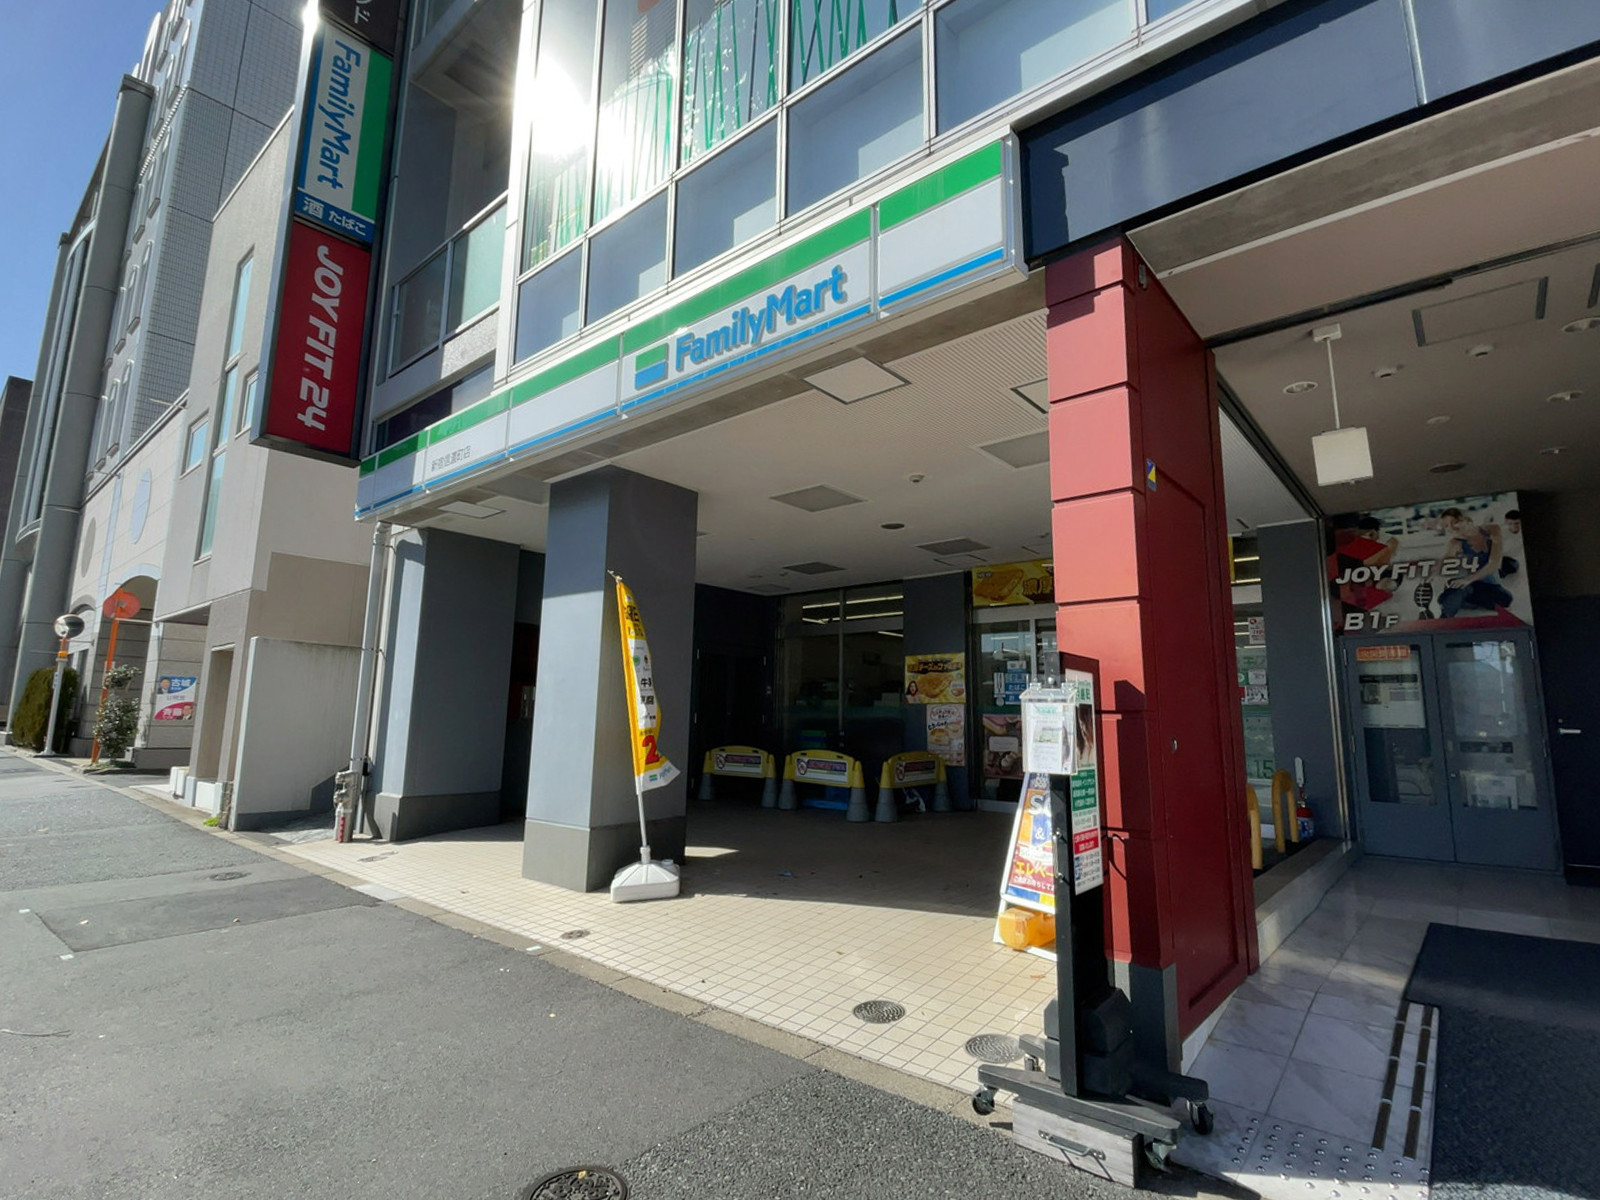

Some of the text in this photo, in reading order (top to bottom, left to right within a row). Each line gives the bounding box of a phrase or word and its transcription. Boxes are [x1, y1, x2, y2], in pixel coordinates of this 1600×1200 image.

[318, 40, 362, 189] FamilyMart
[303, 196, 366, 236] 酒 たばこ
[675, 264, 846, 372] FamilyMart
